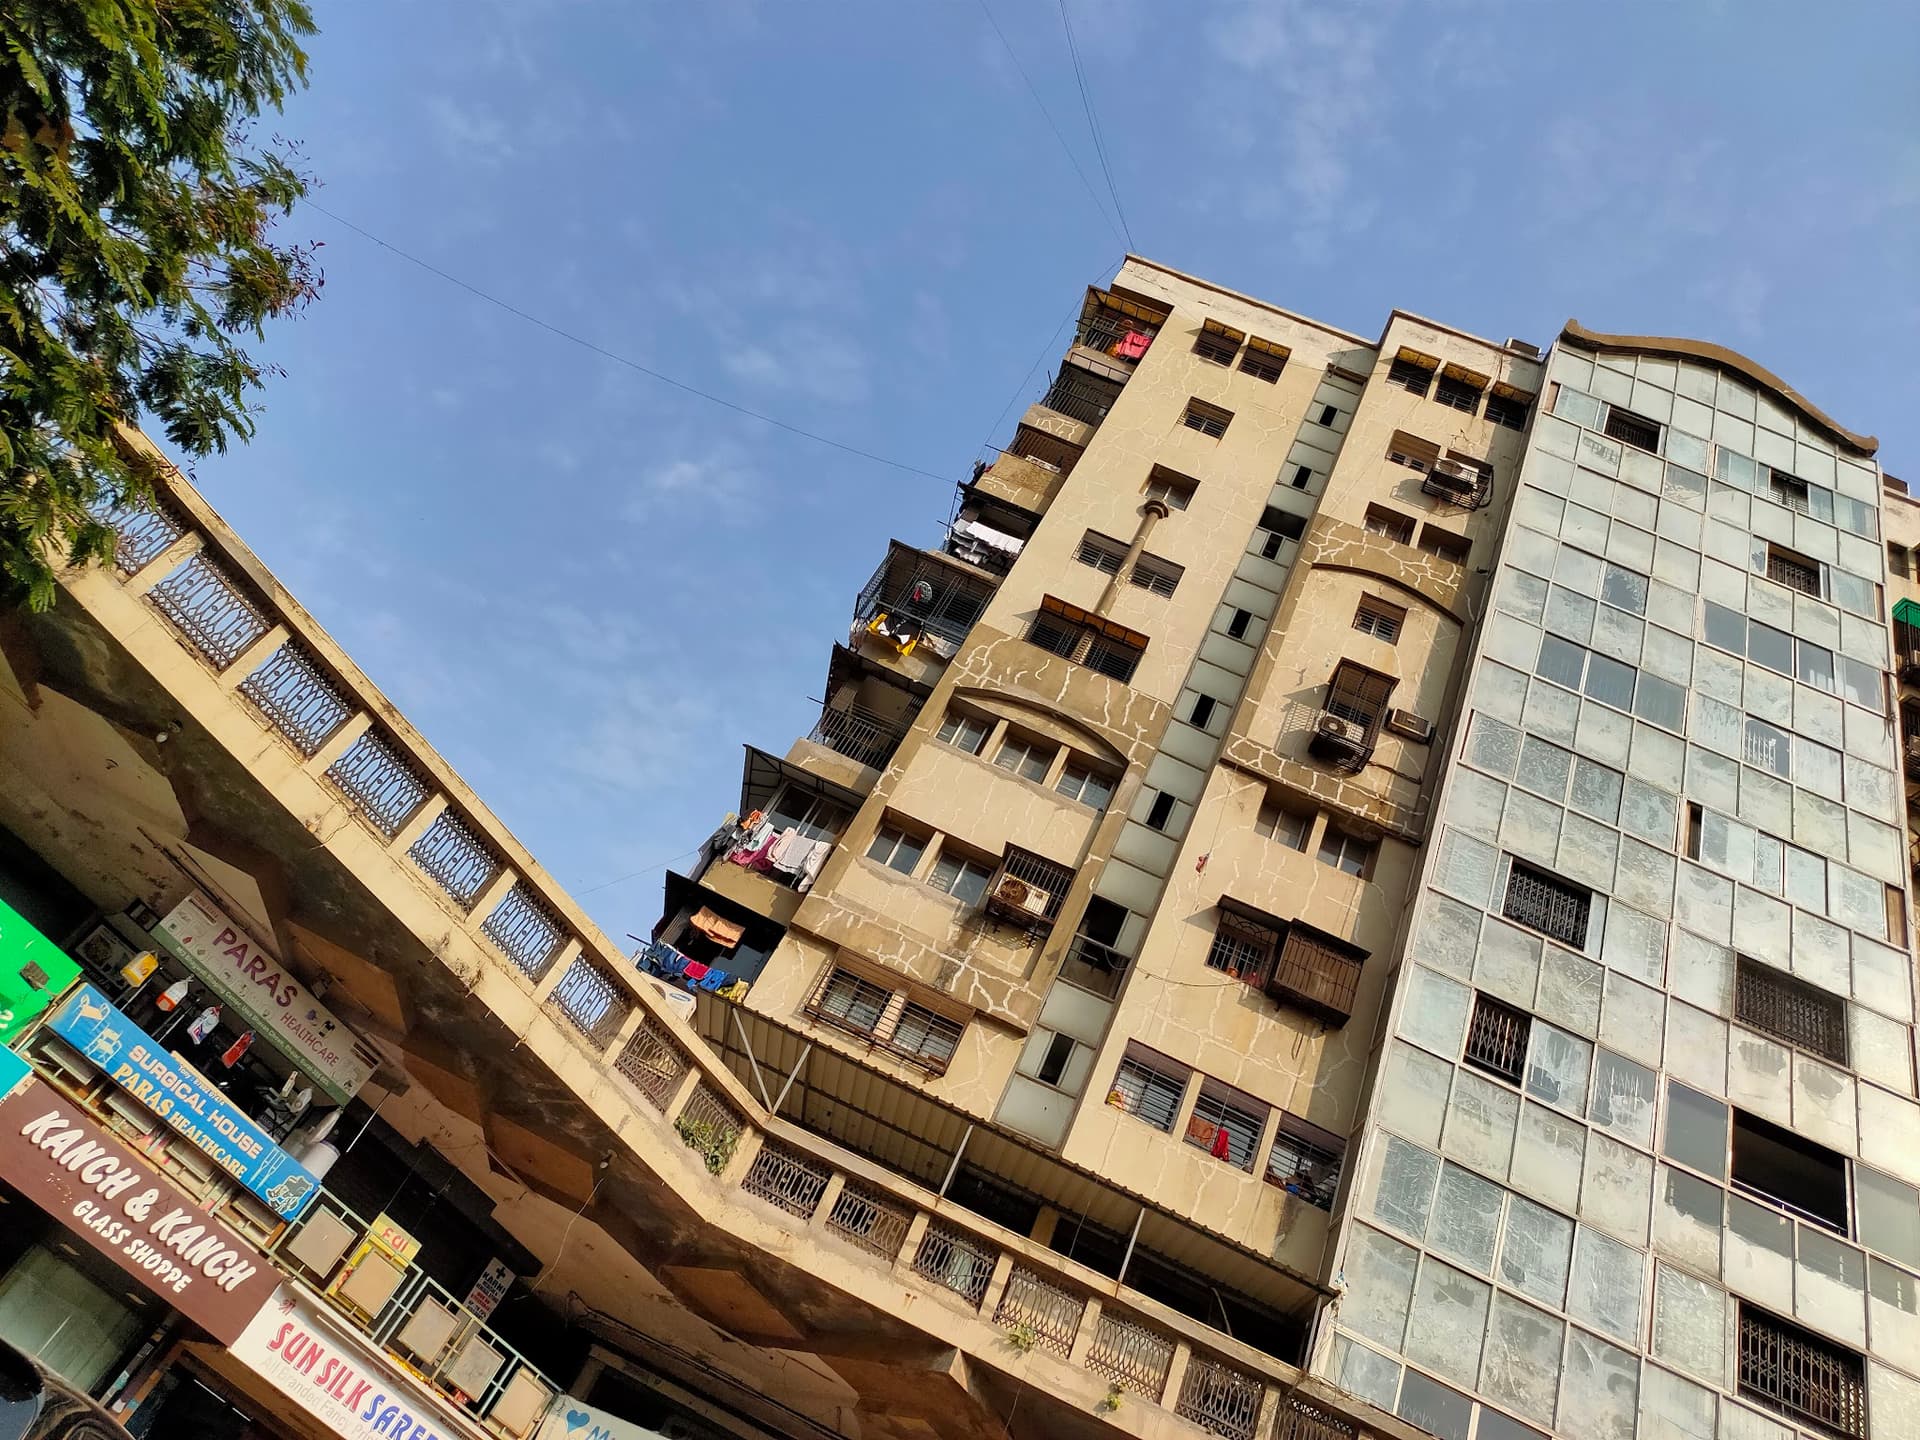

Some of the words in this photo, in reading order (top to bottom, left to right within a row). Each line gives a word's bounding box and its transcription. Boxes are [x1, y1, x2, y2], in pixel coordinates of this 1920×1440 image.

[212, 926, 297, 1007] PARAS
[280, 1012, 340, 1067] HEALTHCARE
[112, 1062, 173, 1125] PARAS
[168, 1111, 249, 1179] HEALTHCARE
[128, 1044, 205, 1116] SURGICAL
[207, 1104, 263, 1160] HOUSE
[21, 1110, 141, 1200] KANCH
[123, 1188, 159, 1223] &
[149, 1207, 257, 1292] KANCH
[72, 1200, 132, 1245] GLASS
[123, 1238, 193, 1293] SHOPPE
[266, 1322, 325, 1377] SUN
[313, 1357, 374, 1414] SILK
[361, 1393, 438, 1440] SARE
